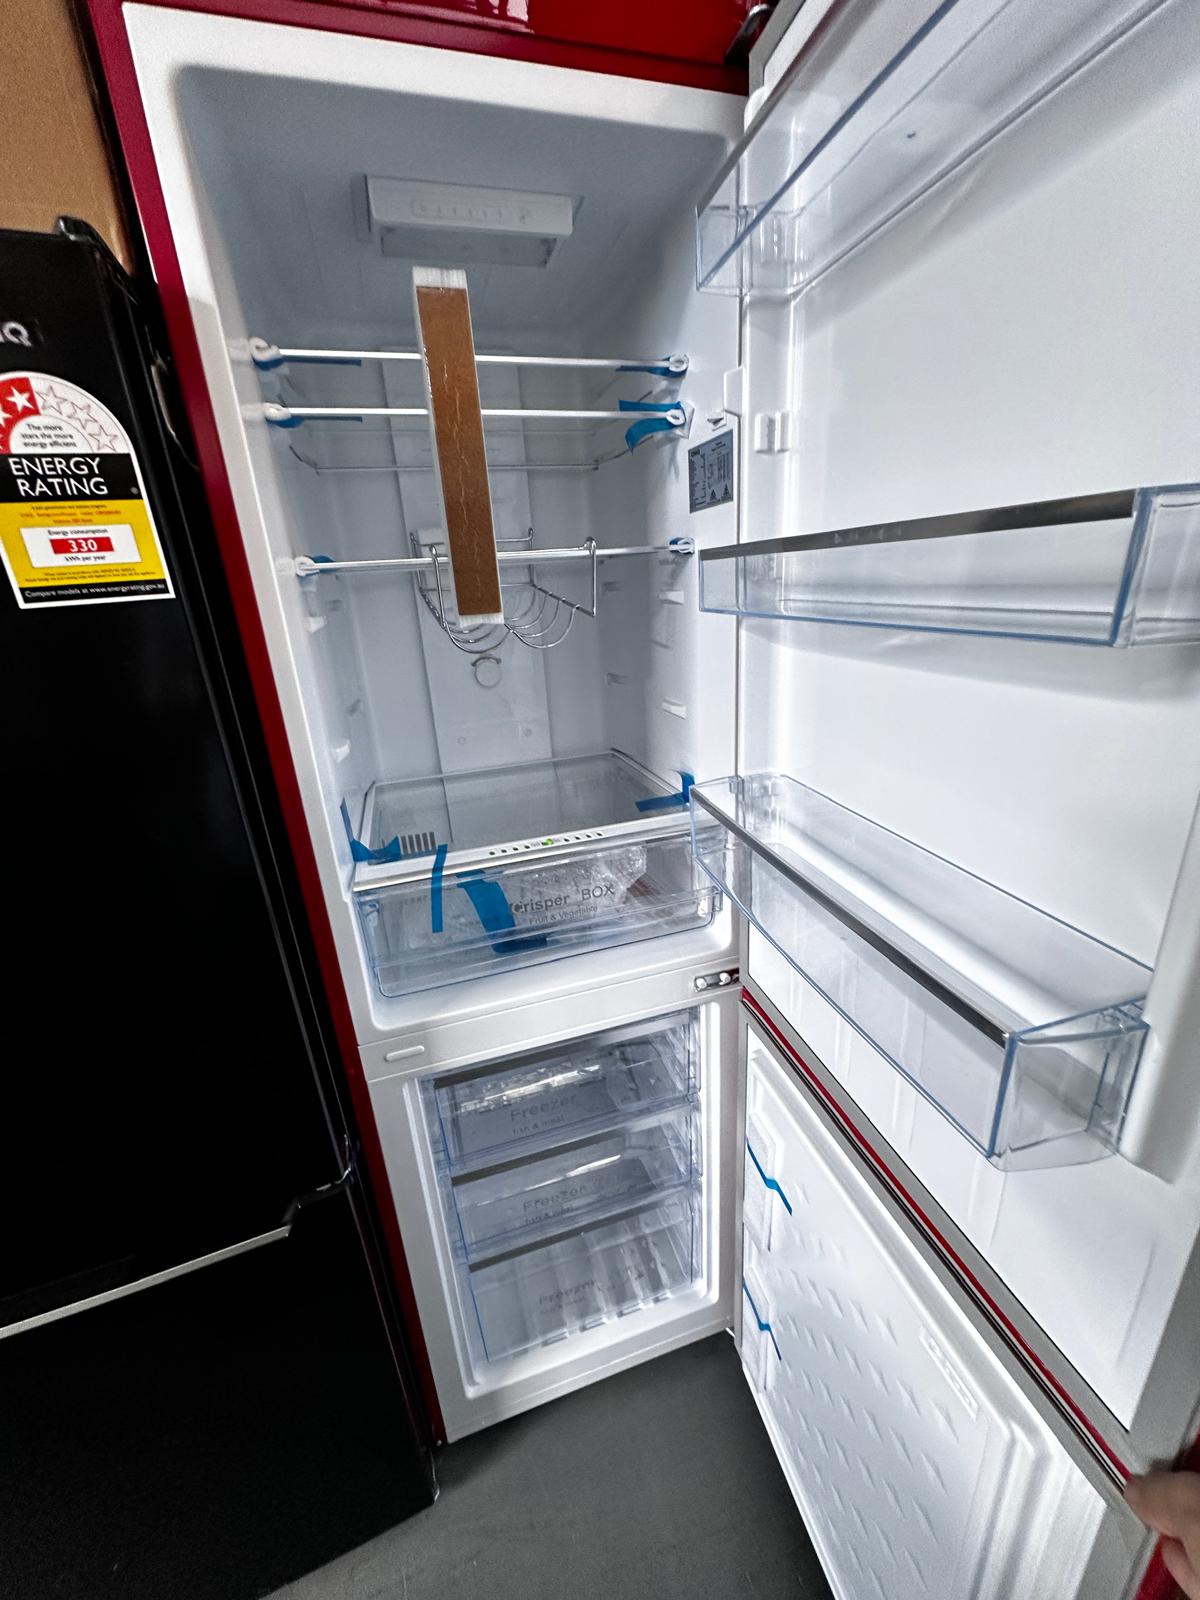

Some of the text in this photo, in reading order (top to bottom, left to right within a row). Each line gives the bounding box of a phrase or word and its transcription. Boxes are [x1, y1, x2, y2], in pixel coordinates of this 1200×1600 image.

[26, 423, 41, 431] The
[8, 456, 100, 476] ENERGY
[16, 476, 109, 497] RATING
[48, 527, 109, 537] Energy consumption
[67, 538, 98, 553] 330
[25, 589, 58, 598] Compare
[58, 587, 81, 596] models
[581, 883, 616, 902] BOX
[510, 1094, 577, 1122] Freezer
[522, 1185, 586, 1212] Freezer
